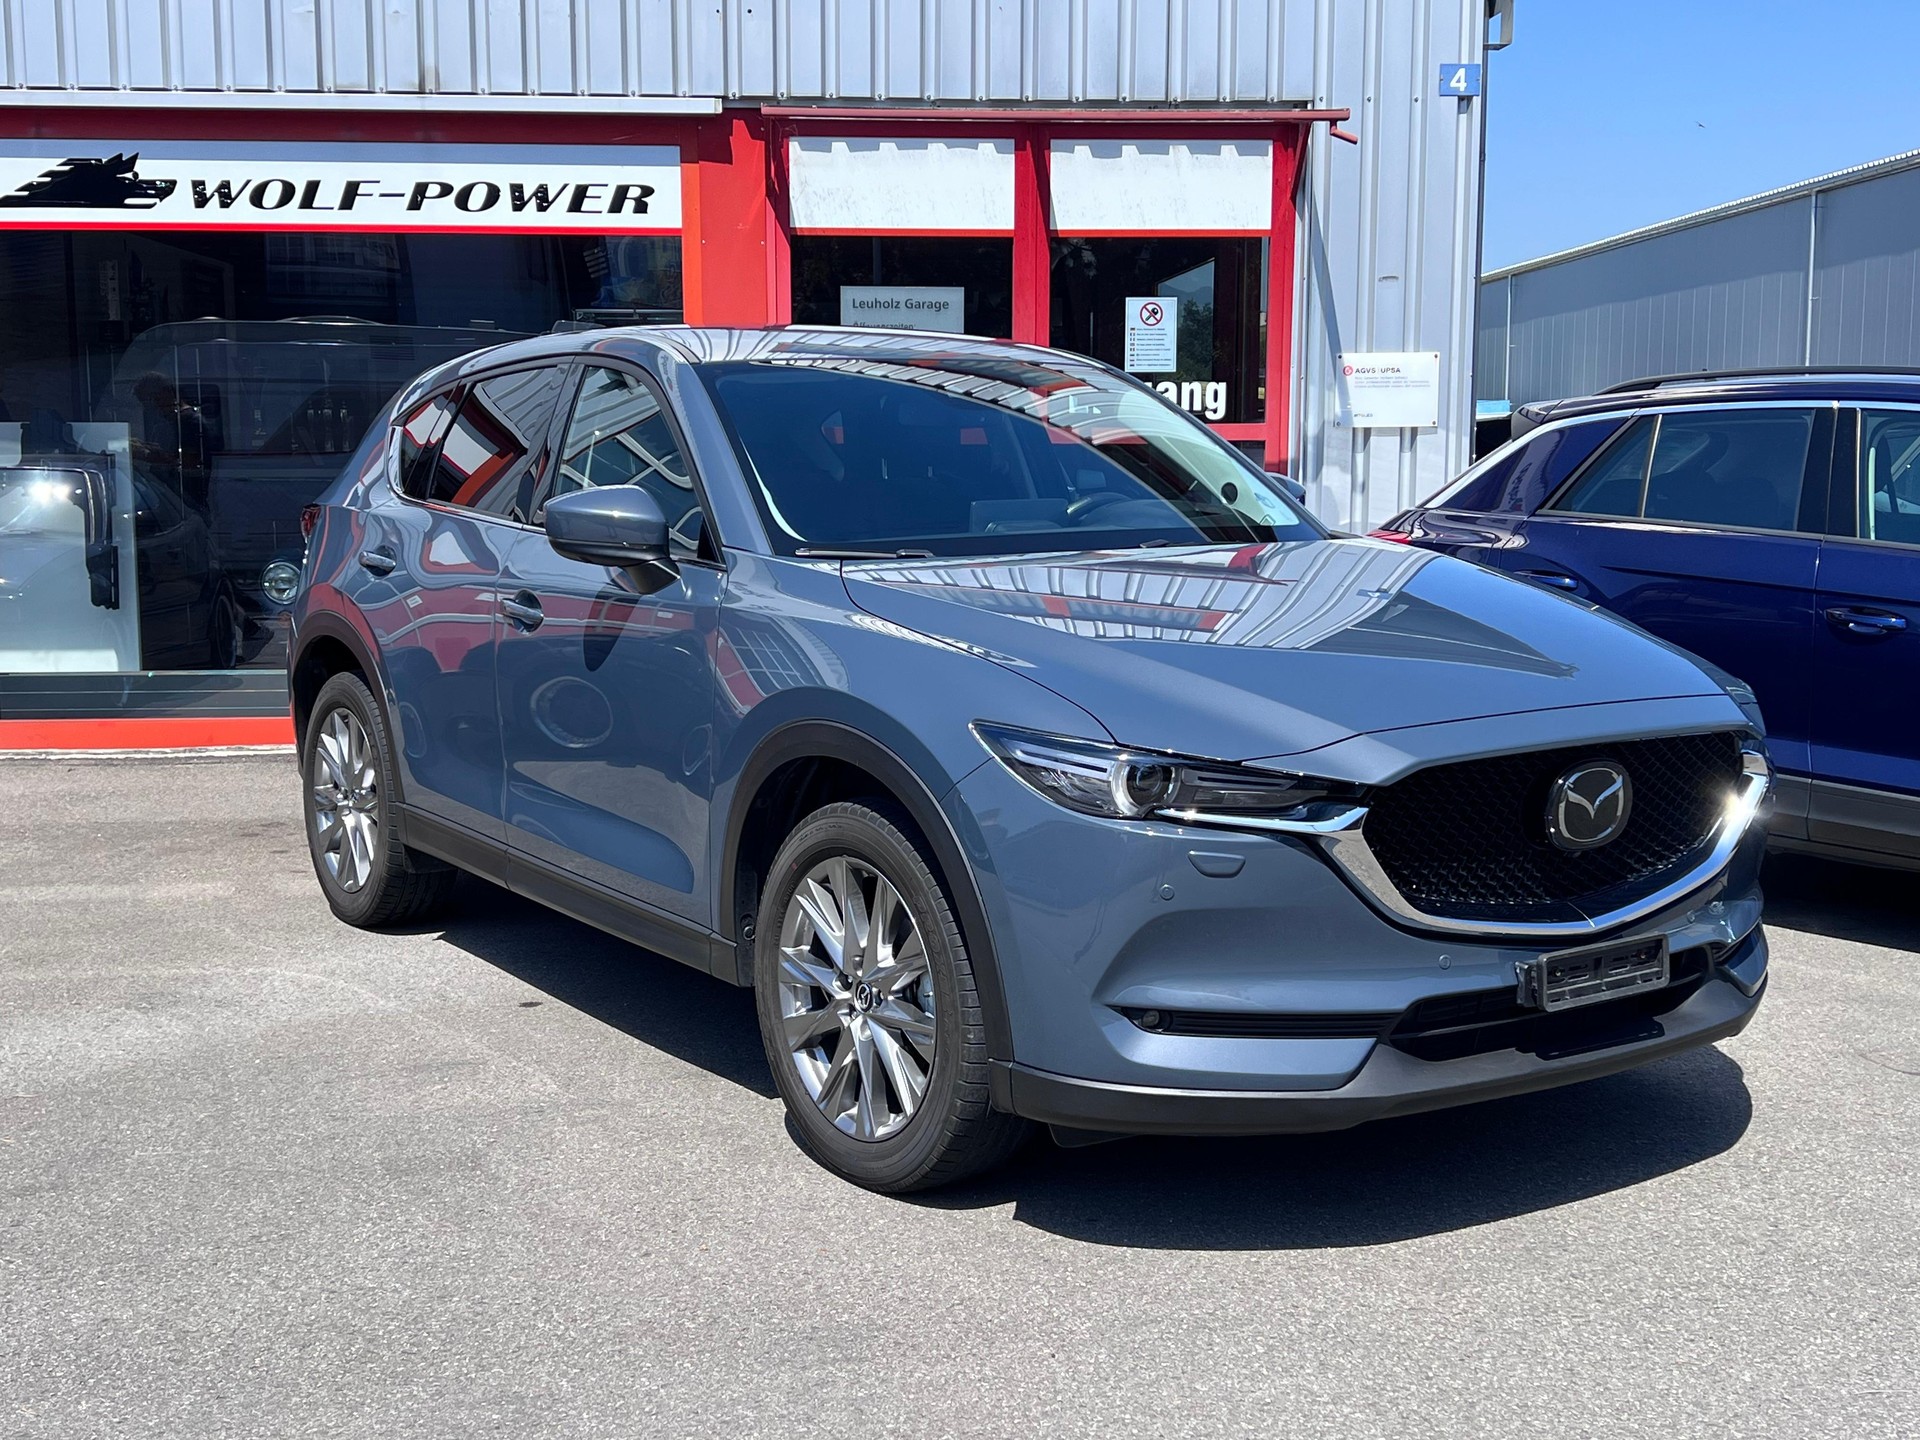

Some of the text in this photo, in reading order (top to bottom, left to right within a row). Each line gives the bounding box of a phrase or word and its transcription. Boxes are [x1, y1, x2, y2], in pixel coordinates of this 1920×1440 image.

[1450, 67, 1467, 92] 4
[191, 178, 655, 214] WOLF-POWER
[852, 298, 949, 312] Leuholz Garage
